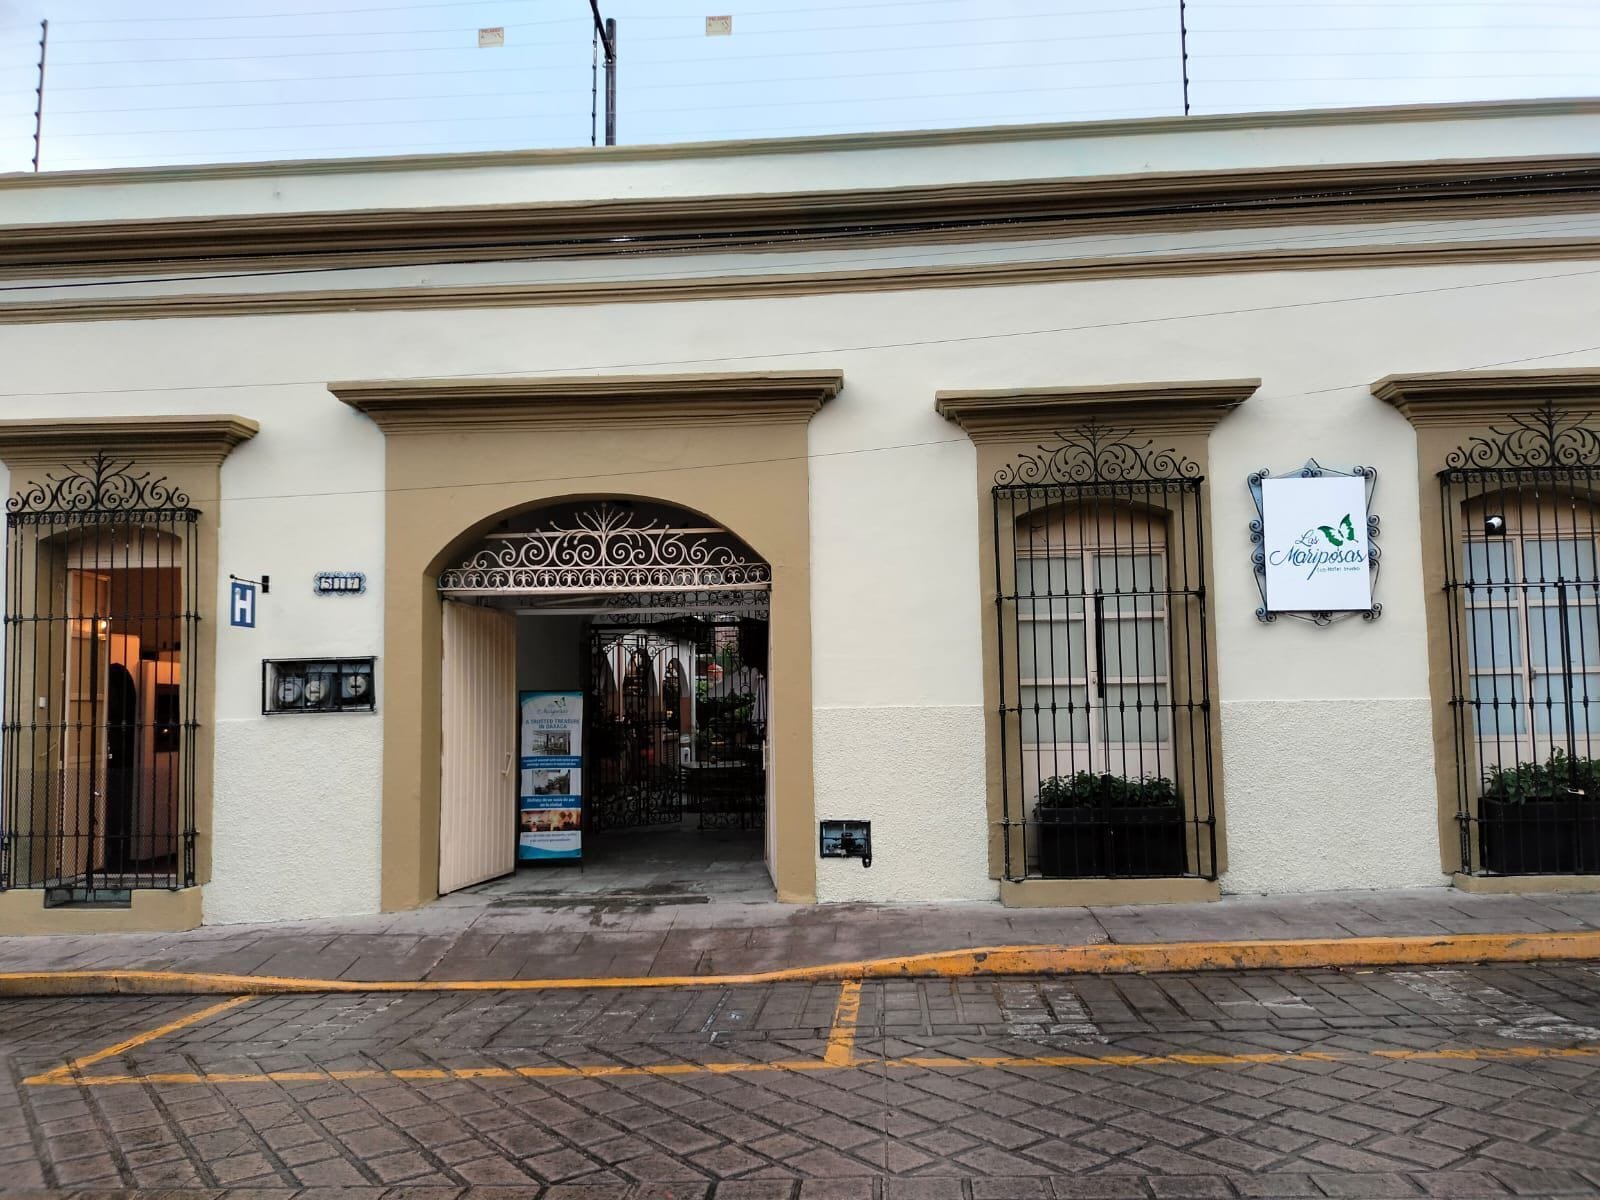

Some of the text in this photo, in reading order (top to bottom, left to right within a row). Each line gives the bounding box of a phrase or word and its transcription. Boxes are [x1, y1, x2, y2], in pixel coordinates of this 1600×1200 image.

[1295, 529, 1320, 547] Las
[1269, 546, 1367, 581] Mariposas
[234, 587, 253, 624] H
